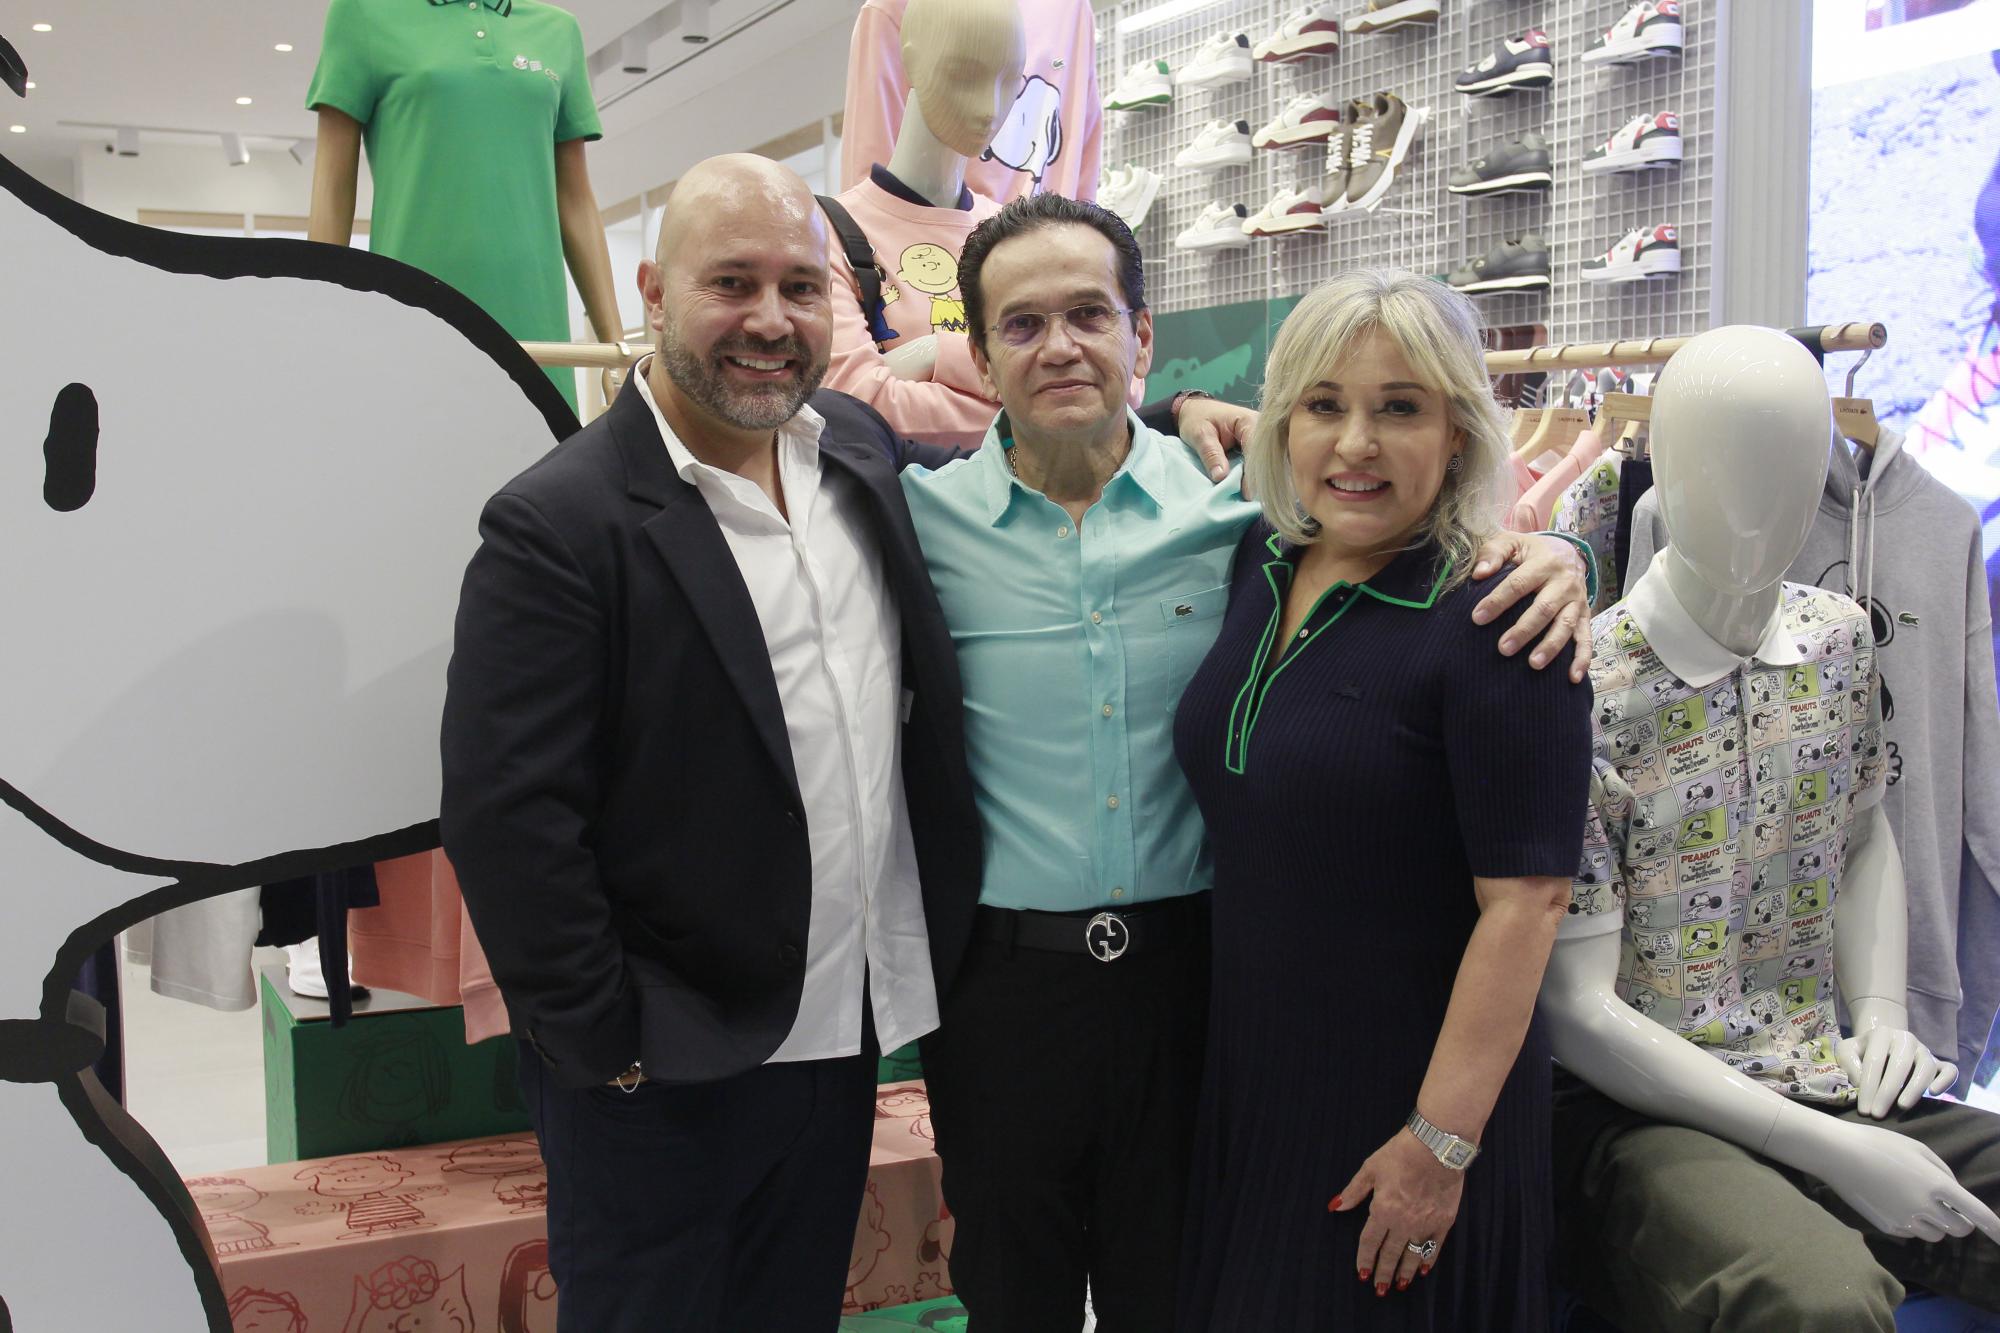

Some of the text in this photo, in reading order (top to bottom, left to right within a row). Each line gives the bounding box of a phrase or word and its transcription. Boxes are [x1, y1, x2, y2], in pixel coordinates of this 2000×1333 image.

[1628, 646, 1653, 660] PEAN
[1790, 701, 1817, 713] PEANUTS
[1666, 735, 1704, 756] PEANUTS
[1795, 808, 1821, 823] PEANUTS
[1681, 847, 1720, 863] PEANUTS
[1791, 914, 1823, 929] PEANUTS
